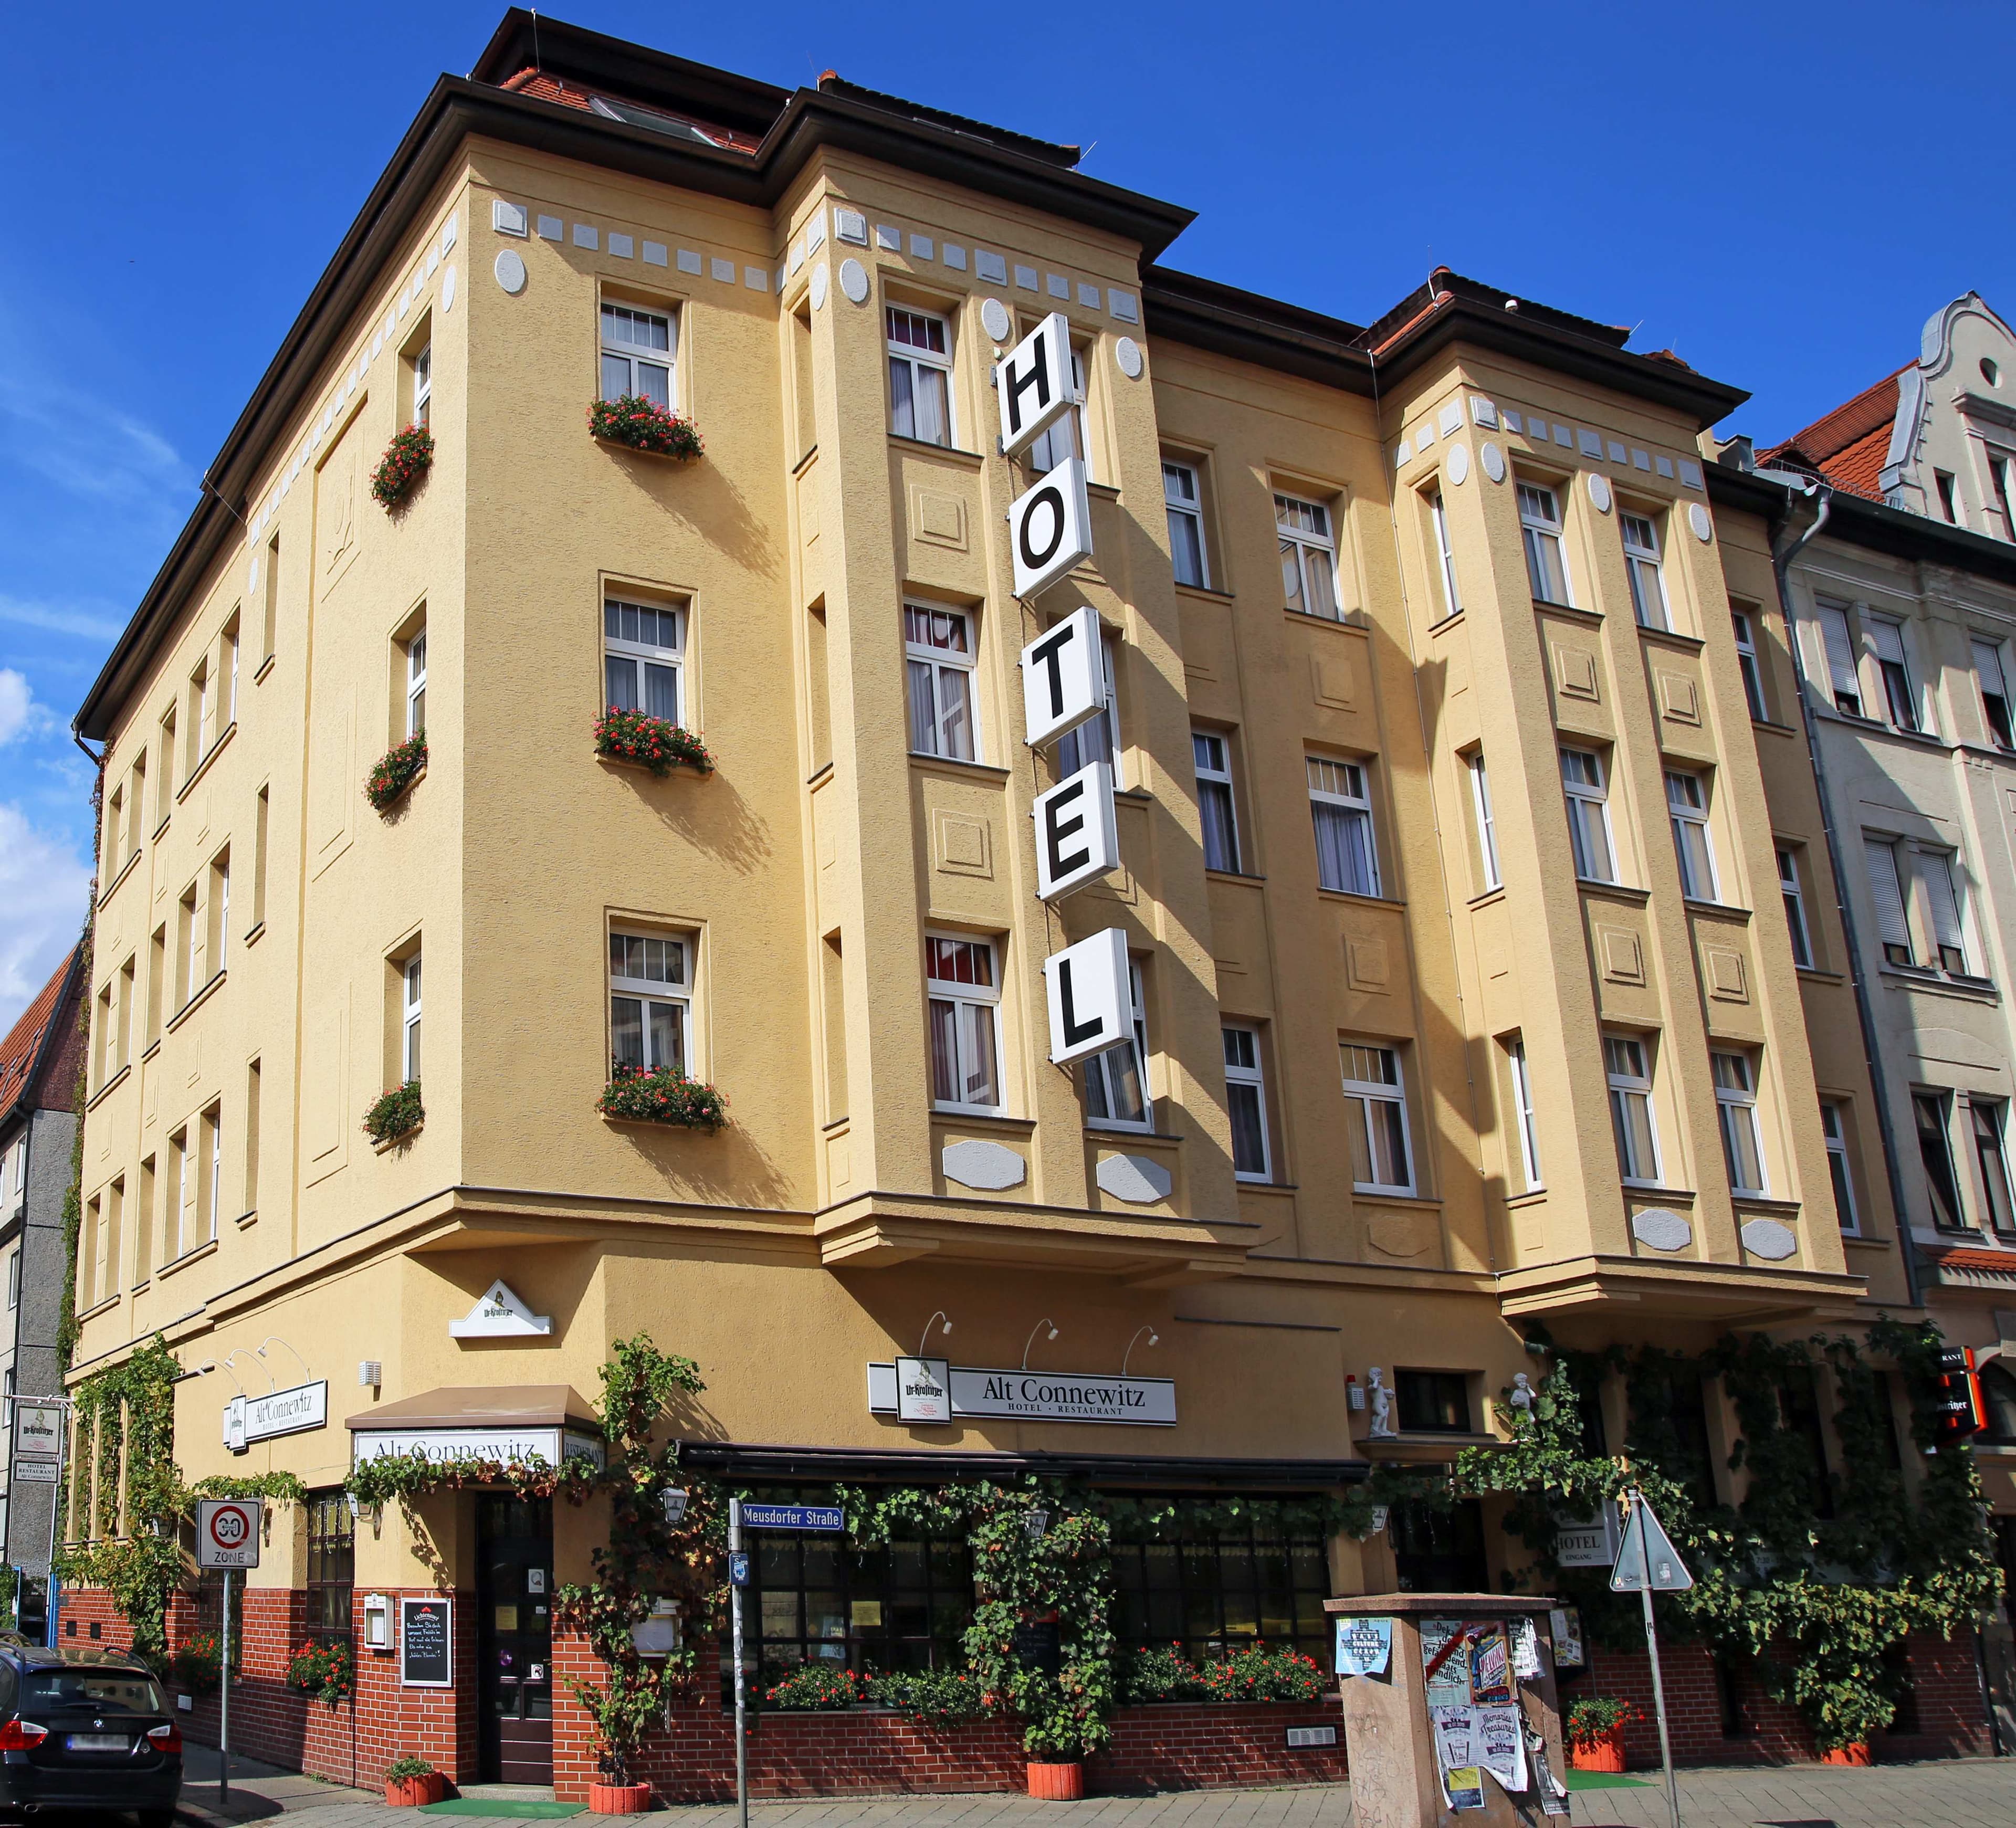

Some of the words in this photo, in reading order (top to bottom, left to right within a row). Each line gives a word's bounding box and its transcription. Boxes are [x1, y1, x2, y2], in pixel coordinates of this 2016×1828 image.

[1005, 331, 1103, 1048] HOTEL
[982, 1377, 1014, 1401] Alt
[1020, 1378, 1146, 1407] Connewitz
[255, 1402, 266, 1424] Alt
[267, 1394, 312, 1420] Connewitz
[1008, 1403, 1042, 1412] HOTEL
[1058, 1405, 1122, 1415] RESTAURANT
[375, 1440, 404, 1457] Alt
[744, 1508, 802, 1524] Meusdorfer
[806, 1510, 839, 1526] Straße
[214, 1551, 245, 1563] ZONE
[1482, 1712, 1513, 1725] Memories
[1480, 1724, 1516, 1735] Treasures
